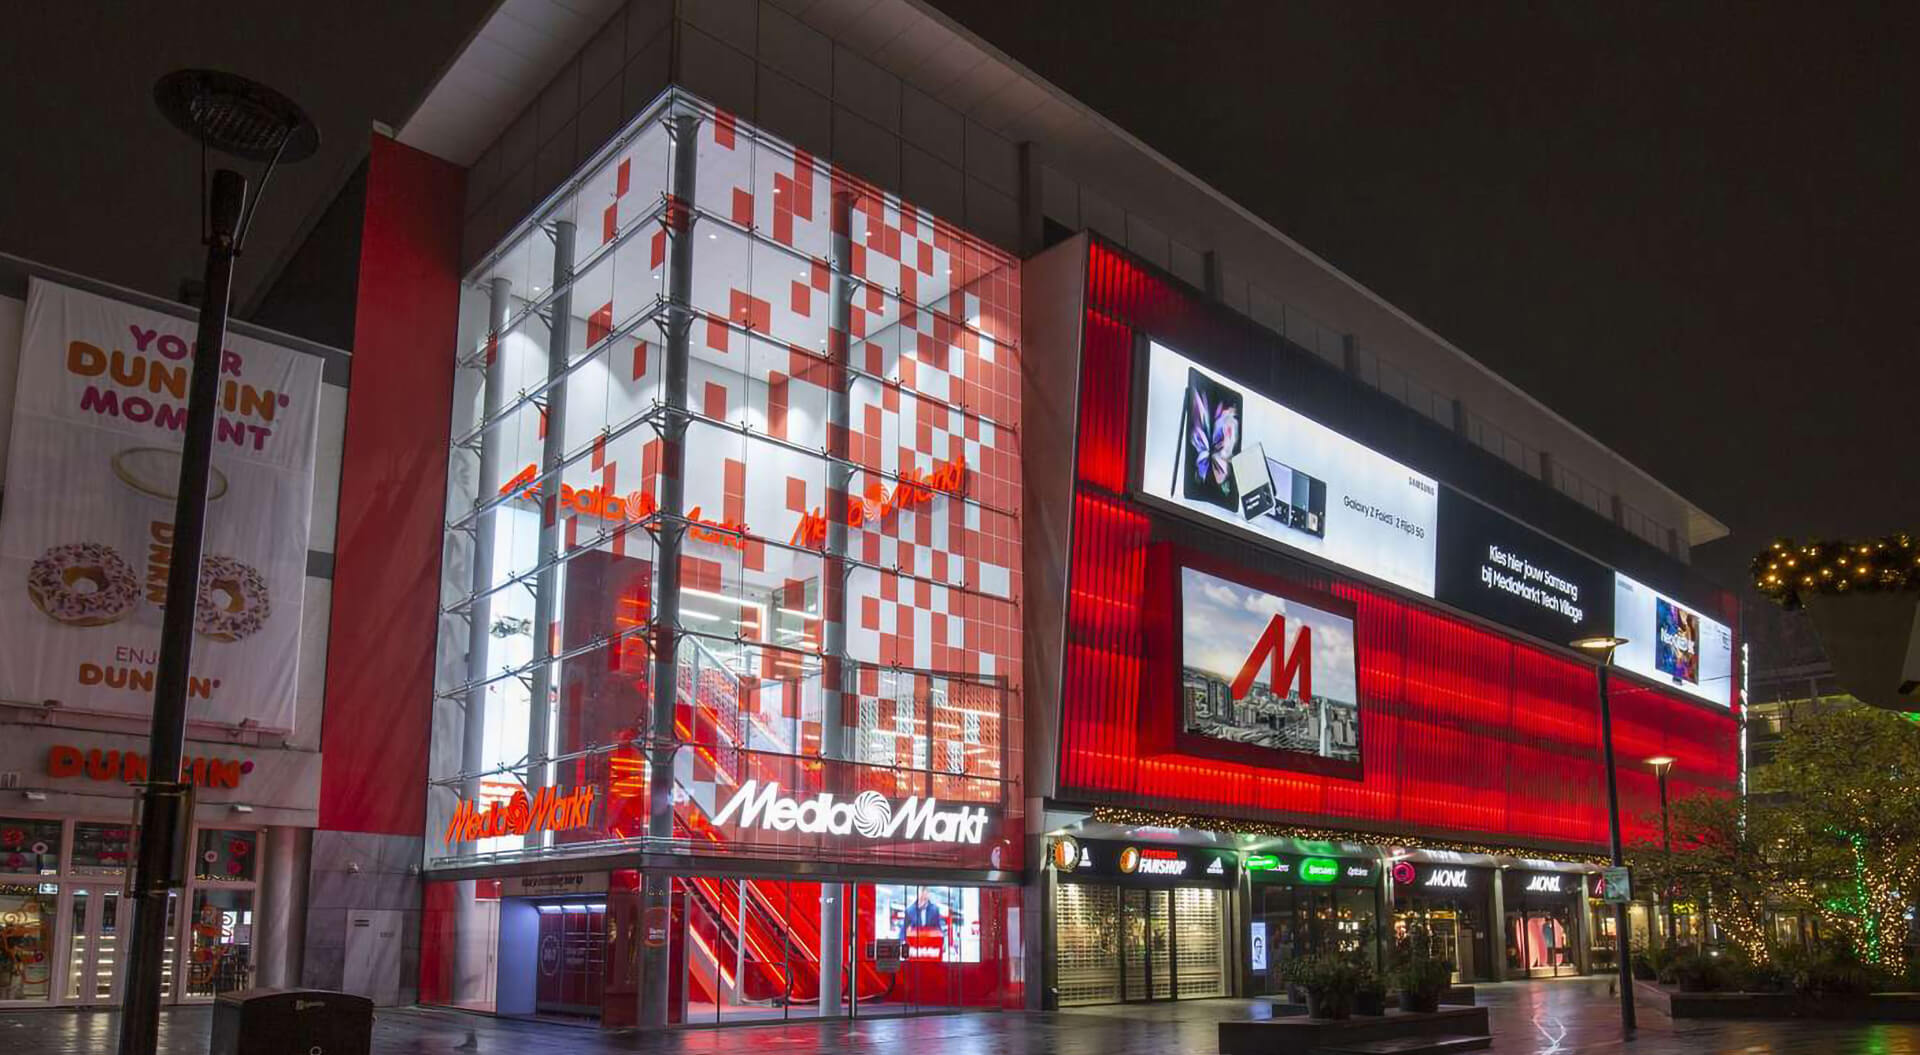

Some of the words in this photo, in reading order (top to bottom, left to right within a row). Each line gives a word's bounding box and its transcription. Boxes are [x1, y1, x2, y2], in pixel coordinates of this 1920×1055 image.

[130, 324, 242, 377] YOR
[67, 340, 290, 422] DUNIN'
[80, 386, 271, 450] MOMNT
[1343, 495, 1370, 518] Galaxy
[1409, 476, 1435, 496] SAMSUNG
[1481, 565, 1493, 588] bij
[1493, 570, 1540, 604] MediaMarkt
[1540, 589, 1560, 612] Tech
[1559, 598, 1583, 624] Village
[1489, 544, 1507, 567] Kies
[1507, 552, 1523, 573] hier
[1523, 559, 1544, 583] jouw
[1544, 569, 1578, 602] Samsung
[78, 662, 222, 700] DUNN'
[445, 797, 507, 843] Media
[523, 785, 595, 833] Markt
[712, 779, 854, 835] Media
[881, 795, 989, 844] Markt
[1138, 857, 1187, 875] FANSHOP
[1425, 868, 1468, 888] MONKI
[1526, 875, 1561, 892] MONKI
